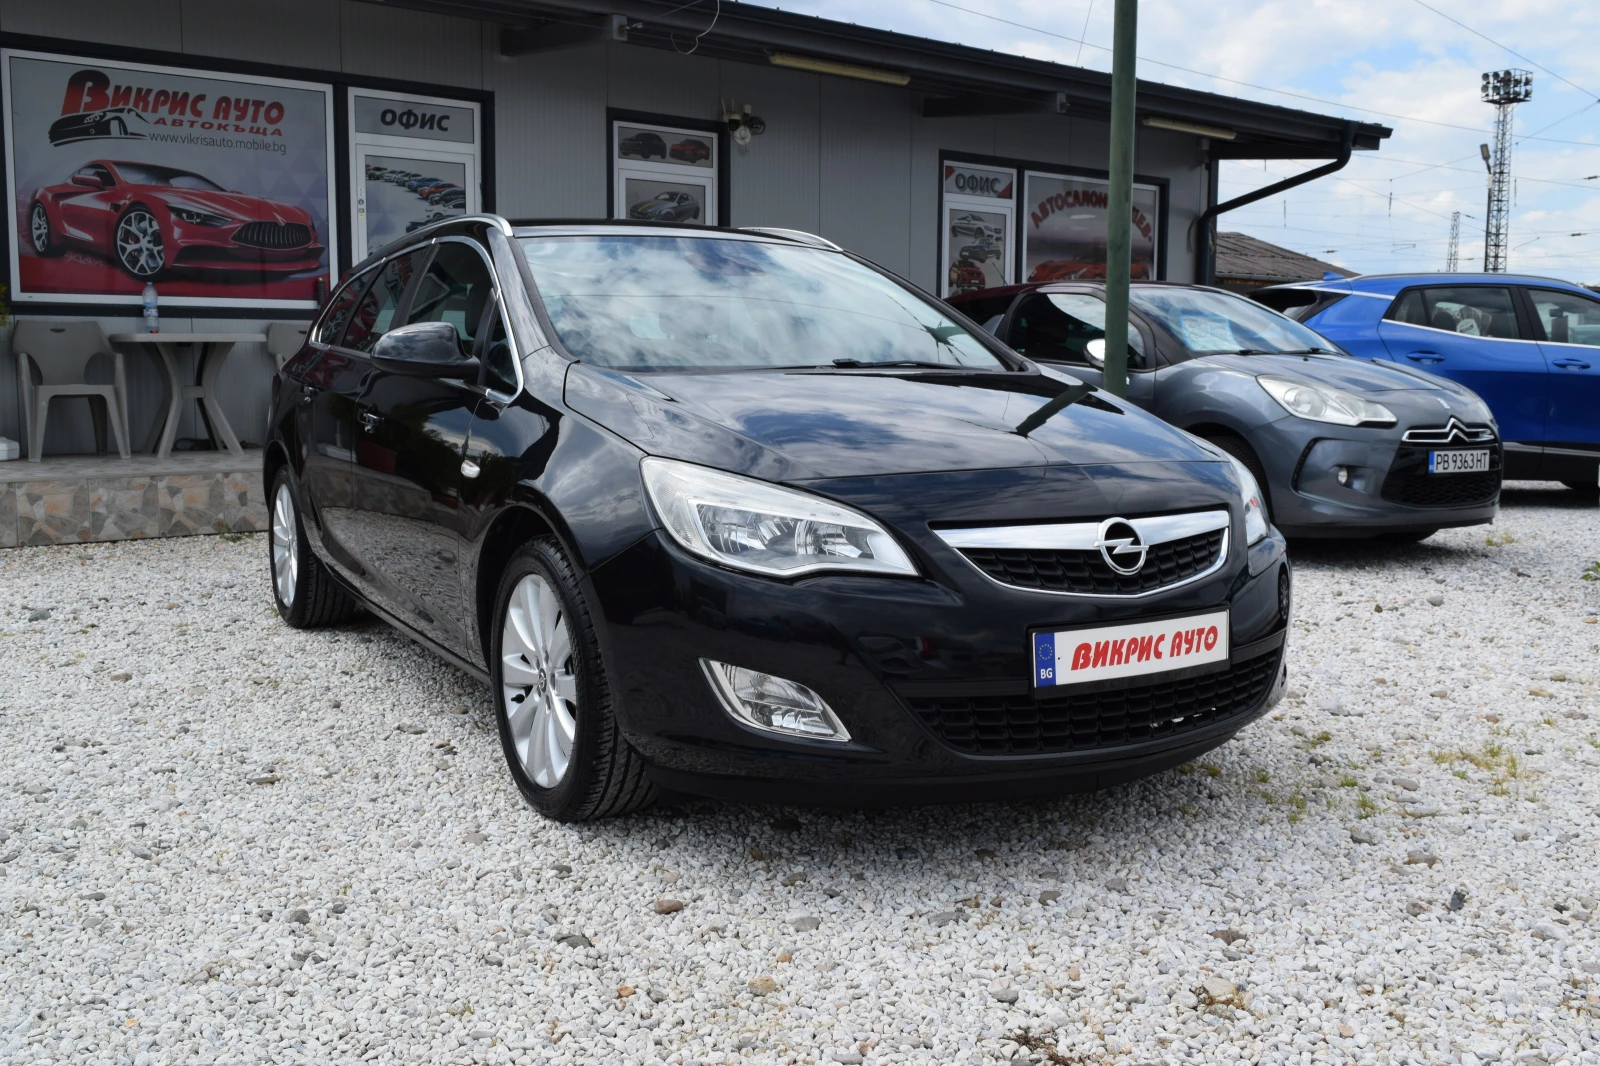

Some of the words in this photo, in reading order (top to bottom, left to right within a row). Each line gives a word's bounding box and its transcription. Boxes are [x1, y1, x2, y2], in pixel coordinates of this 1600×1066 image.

[61, 69, 207, 118] ВИКРИС
[213, 95, 285, 126] АУТО
[152, 117, 283, 137] АВТОКЪЩА
[380, 108, 450, 132] ОФИС
[148, 131, 287, 155] www.vikrisauto.mobile.bg
[955, 173, 1001, 194] ОФИС
[1030, 189, 1109, 229] АВТОСАЛОН
[1435, 453, 1450, 471] PB
[1451, 453, 1475, 470] 9363
[1475, 452, 1488, 469] HT
[1071, 633, 1166, 671] ВИКРИС
[1169, 625, 1218, 658] АУТО
[1040, 667, 1053, 680] BG
